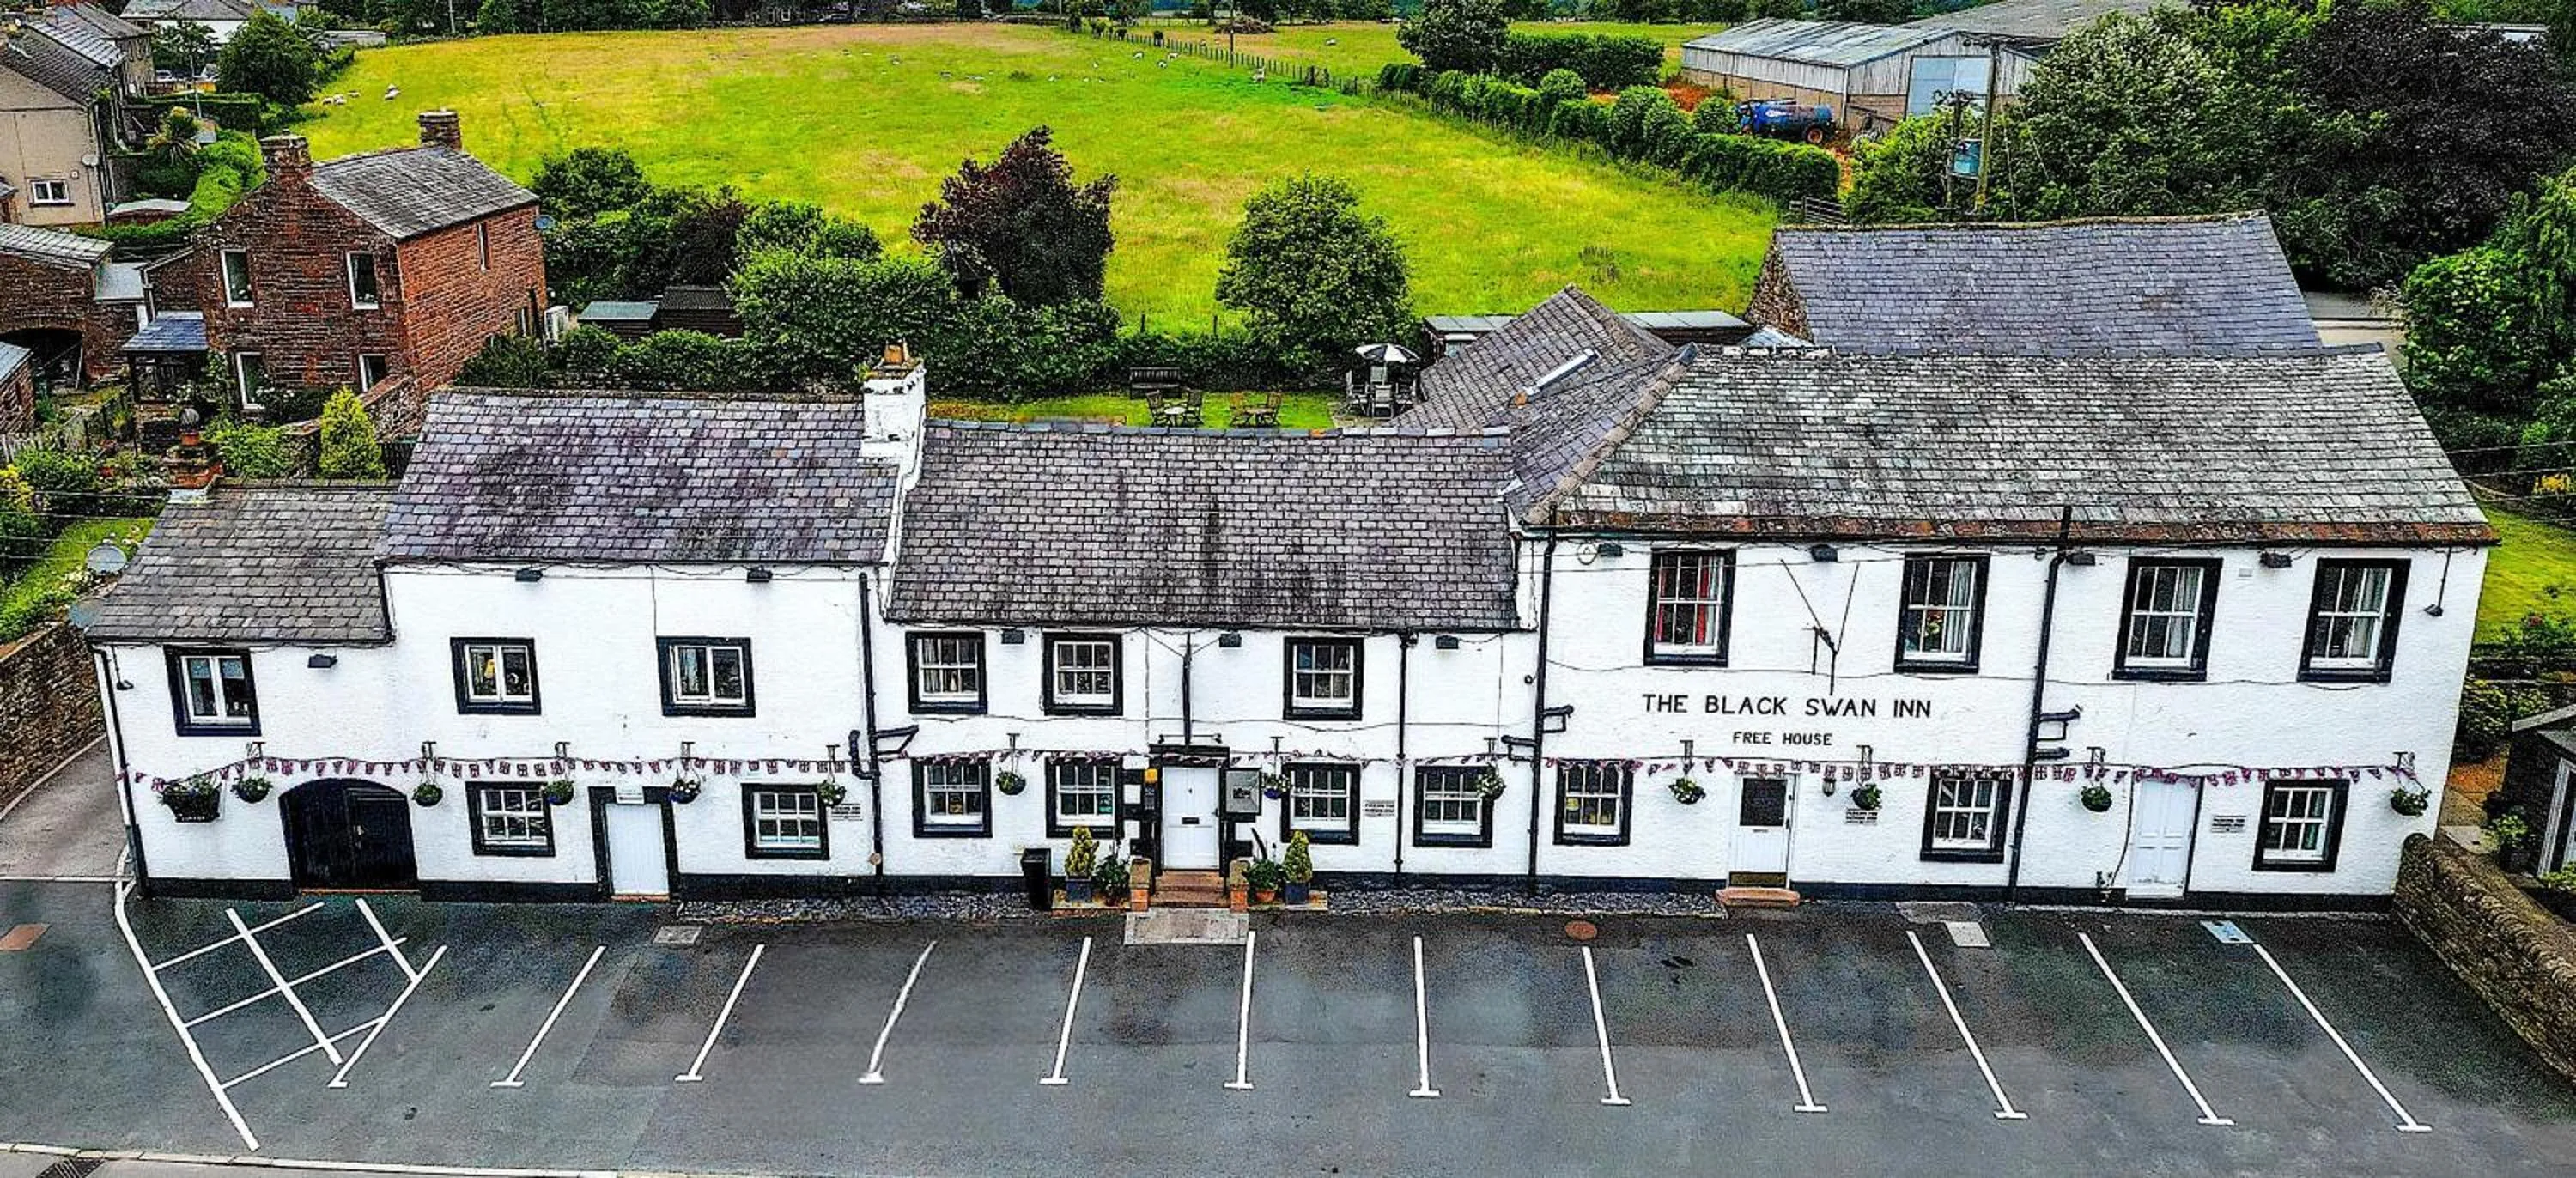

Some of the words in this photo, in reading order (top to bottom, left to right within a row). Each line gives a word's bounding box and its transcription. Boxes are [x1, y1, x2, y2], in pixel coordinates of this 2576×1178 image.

[1643, 694, 1688, 713] THE
[1705, 695, 1787, 714] BLACK
[1805, 698, 1875, 717] SWAN
[1894, 700, 1930, 718] INN
[1733, 732, 1771, 744] FREE
[1783, 733, 1832, 745] HOUSE
